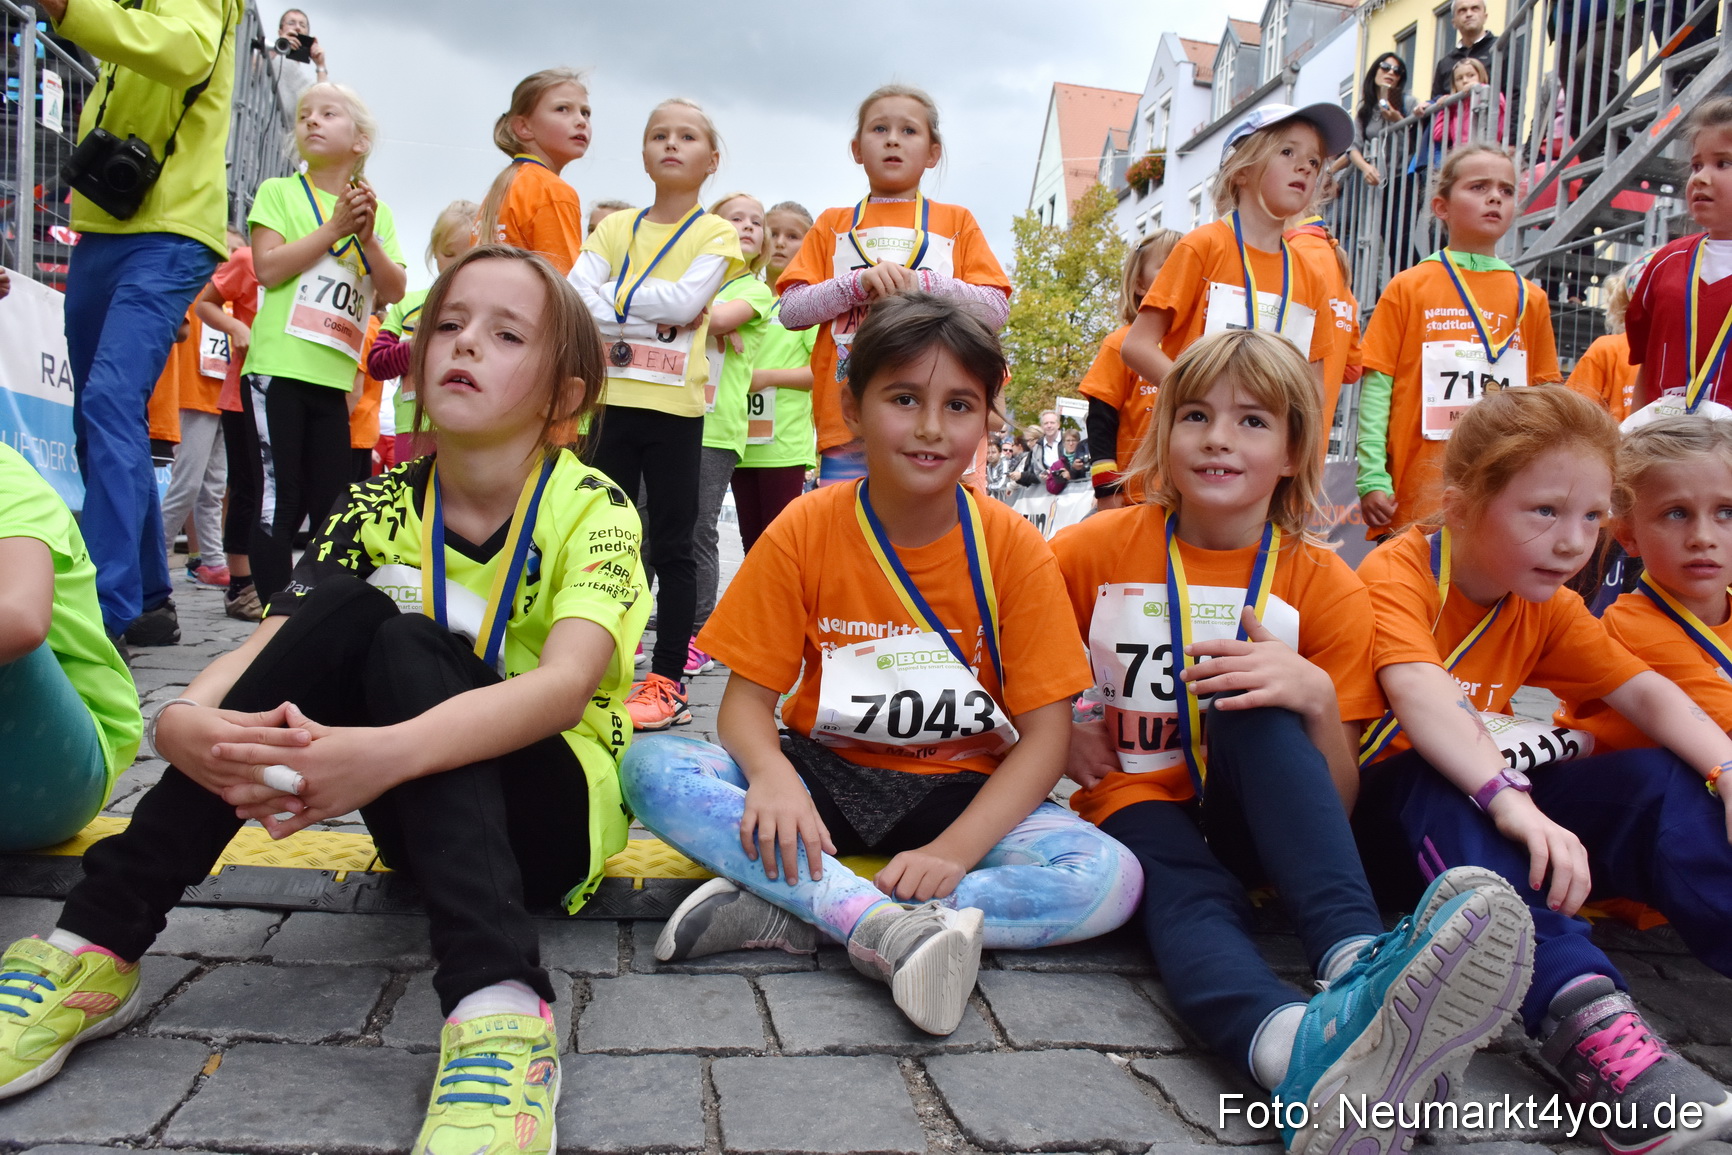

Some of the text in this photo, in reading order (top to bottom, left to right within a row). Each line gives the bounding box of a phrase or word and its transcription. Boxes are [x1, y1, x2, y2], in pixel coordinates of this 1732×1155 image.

[314, 275, 365, 322] 7036
[1424, 307, 1495, 321] Neumarter
[1426, 319, 1476, 332] Stadtlau
[600, 560, 631, 580] ABR
[587, 581, 619, 599] YEARS
[1164, 602, 1235, 620] OCK
[851, 689, 996, 739] 7043
